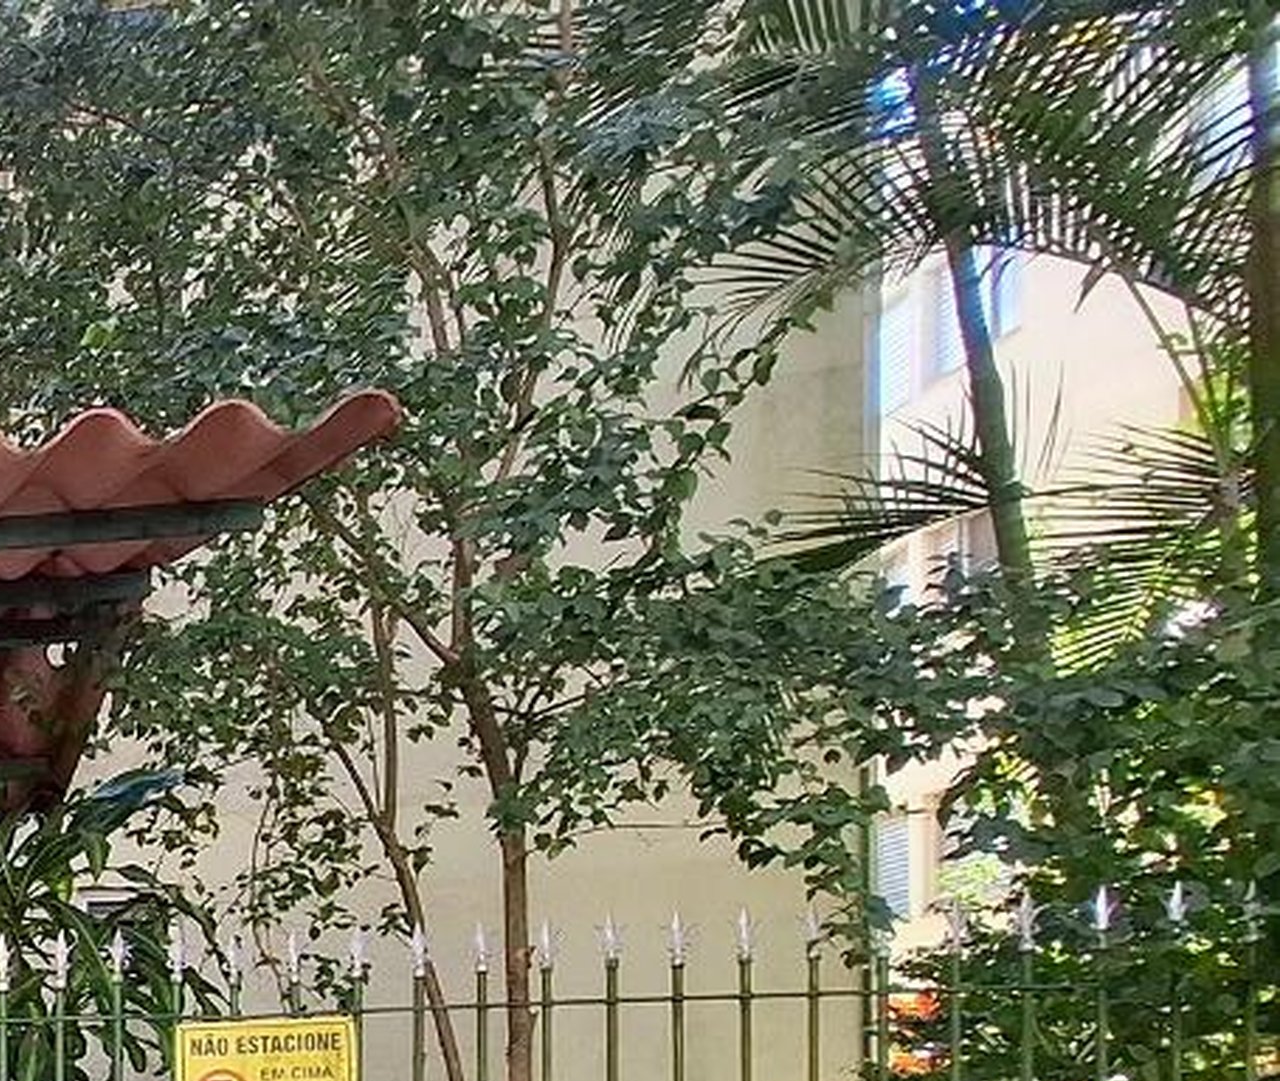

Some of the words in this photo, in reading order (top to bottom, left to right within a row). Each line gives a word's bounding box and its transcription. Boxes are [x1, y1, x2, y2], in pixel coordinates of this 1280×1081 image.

[190, 1034, 228, 1056] NÃO
[236, 1032, 341, 1054] ESTACIONE
[260, 1067, 285, 1081] EM
[291, 1066, 335, 1080] CIMA
